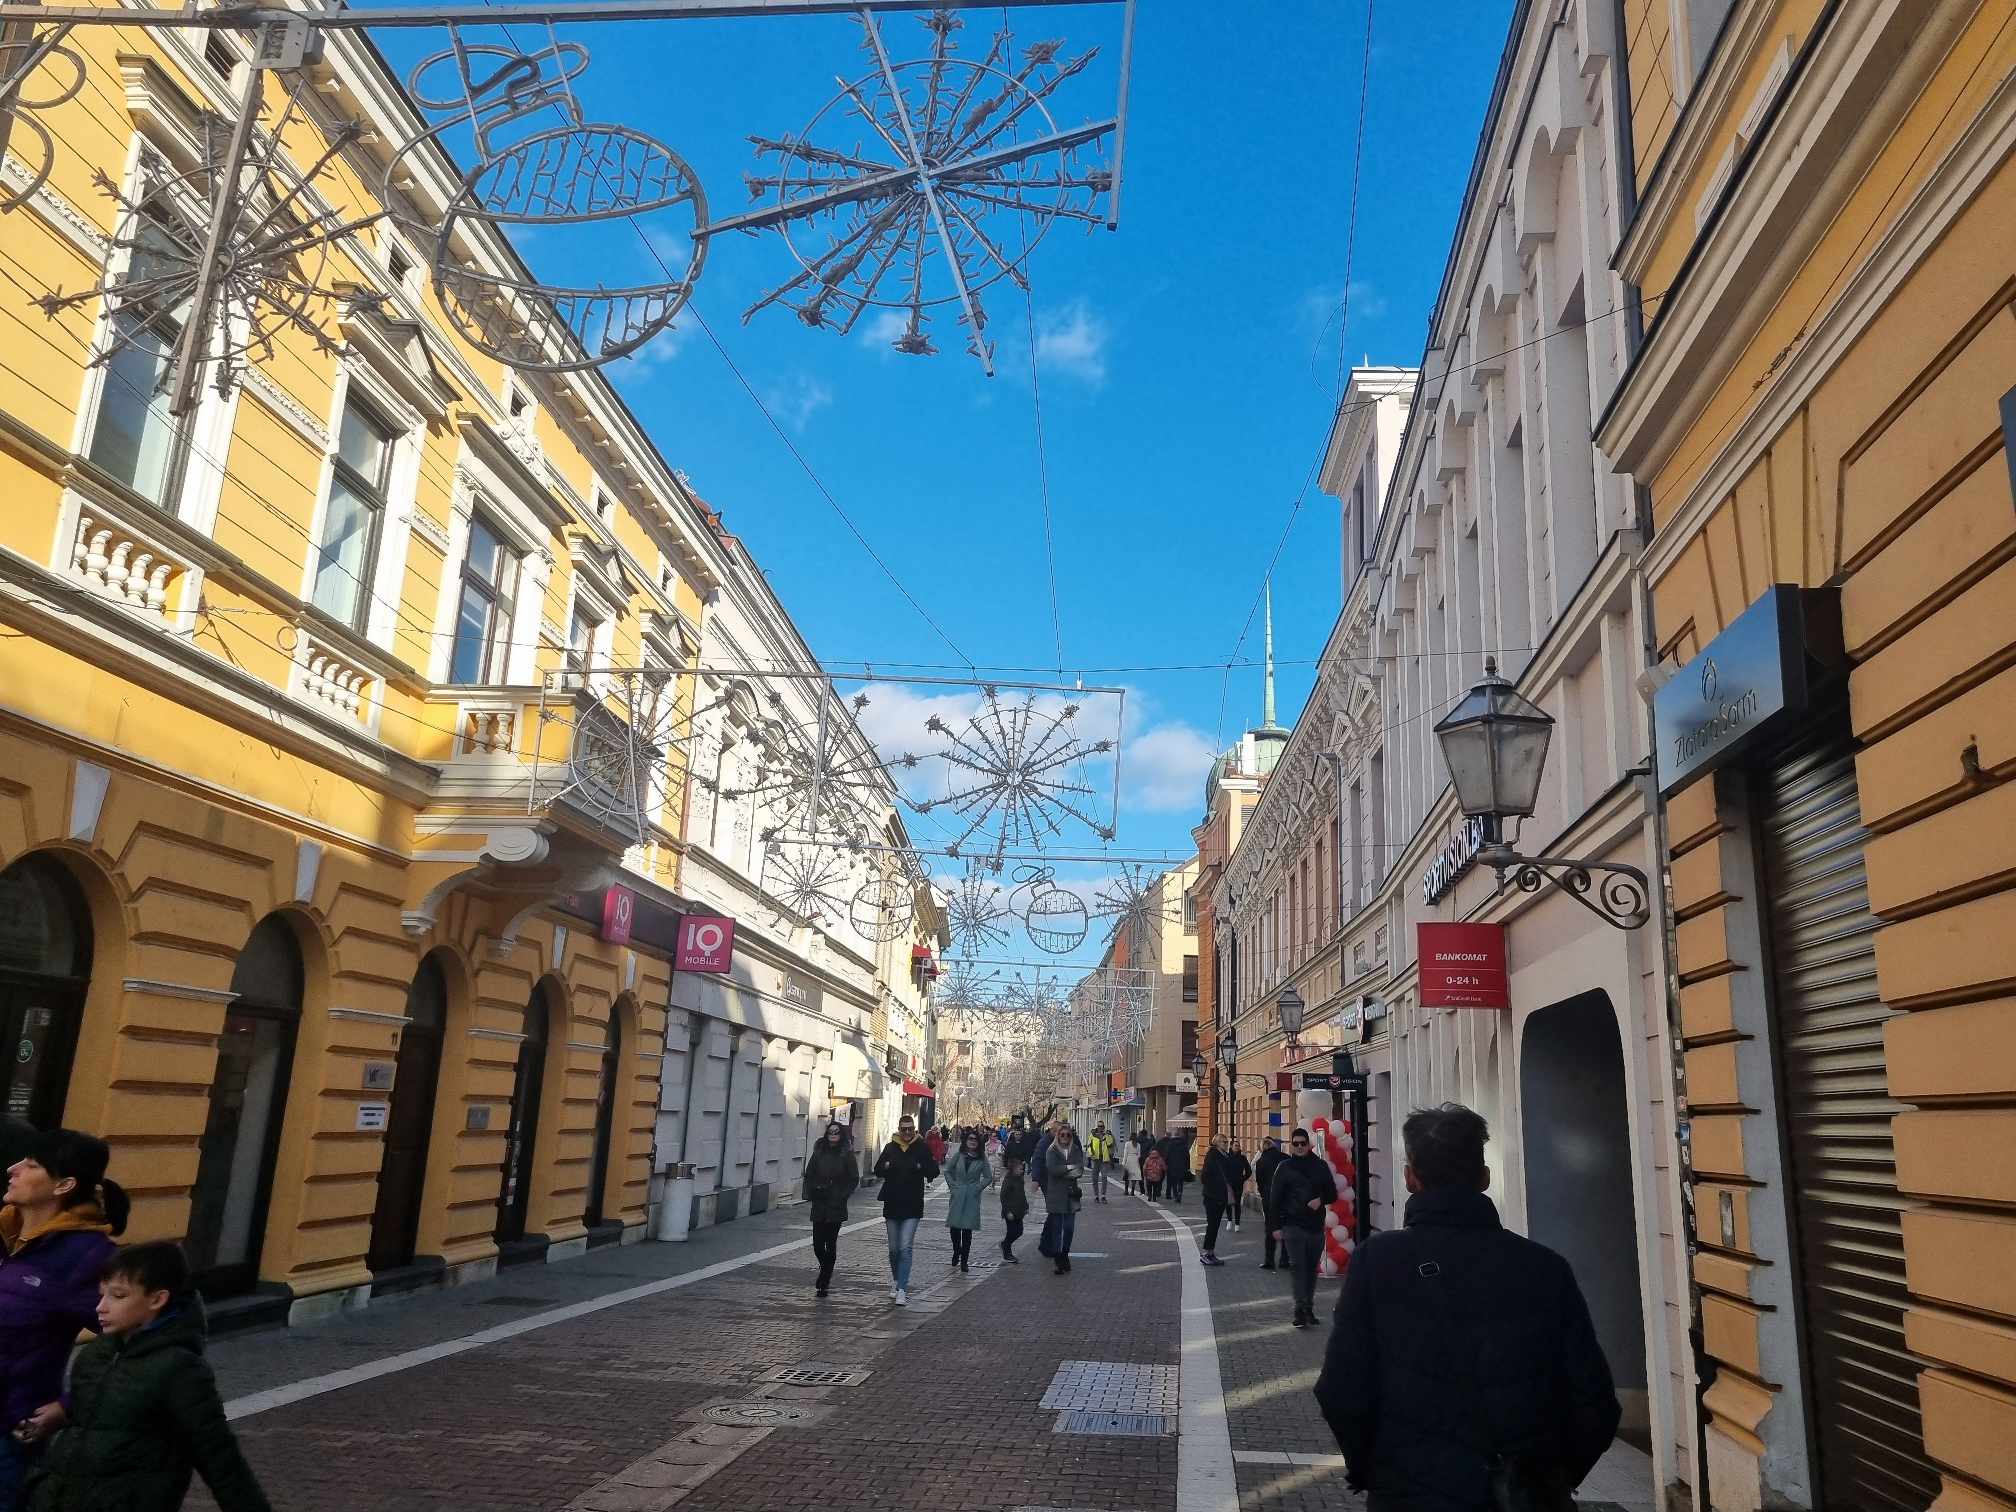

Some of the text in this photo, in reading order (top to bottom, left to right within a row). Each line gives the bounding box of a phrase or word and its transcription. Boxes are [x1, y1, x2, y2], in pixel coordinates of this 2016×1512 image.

[616, 893, 630, 928] IQ
[686, 923, 724, 957] IQ
[685, 956, 720, 966] MOBILE
[1435, 953, 1488, 961] BANKOMAT
[1446, 976, 1479, 985] 0-24 h
